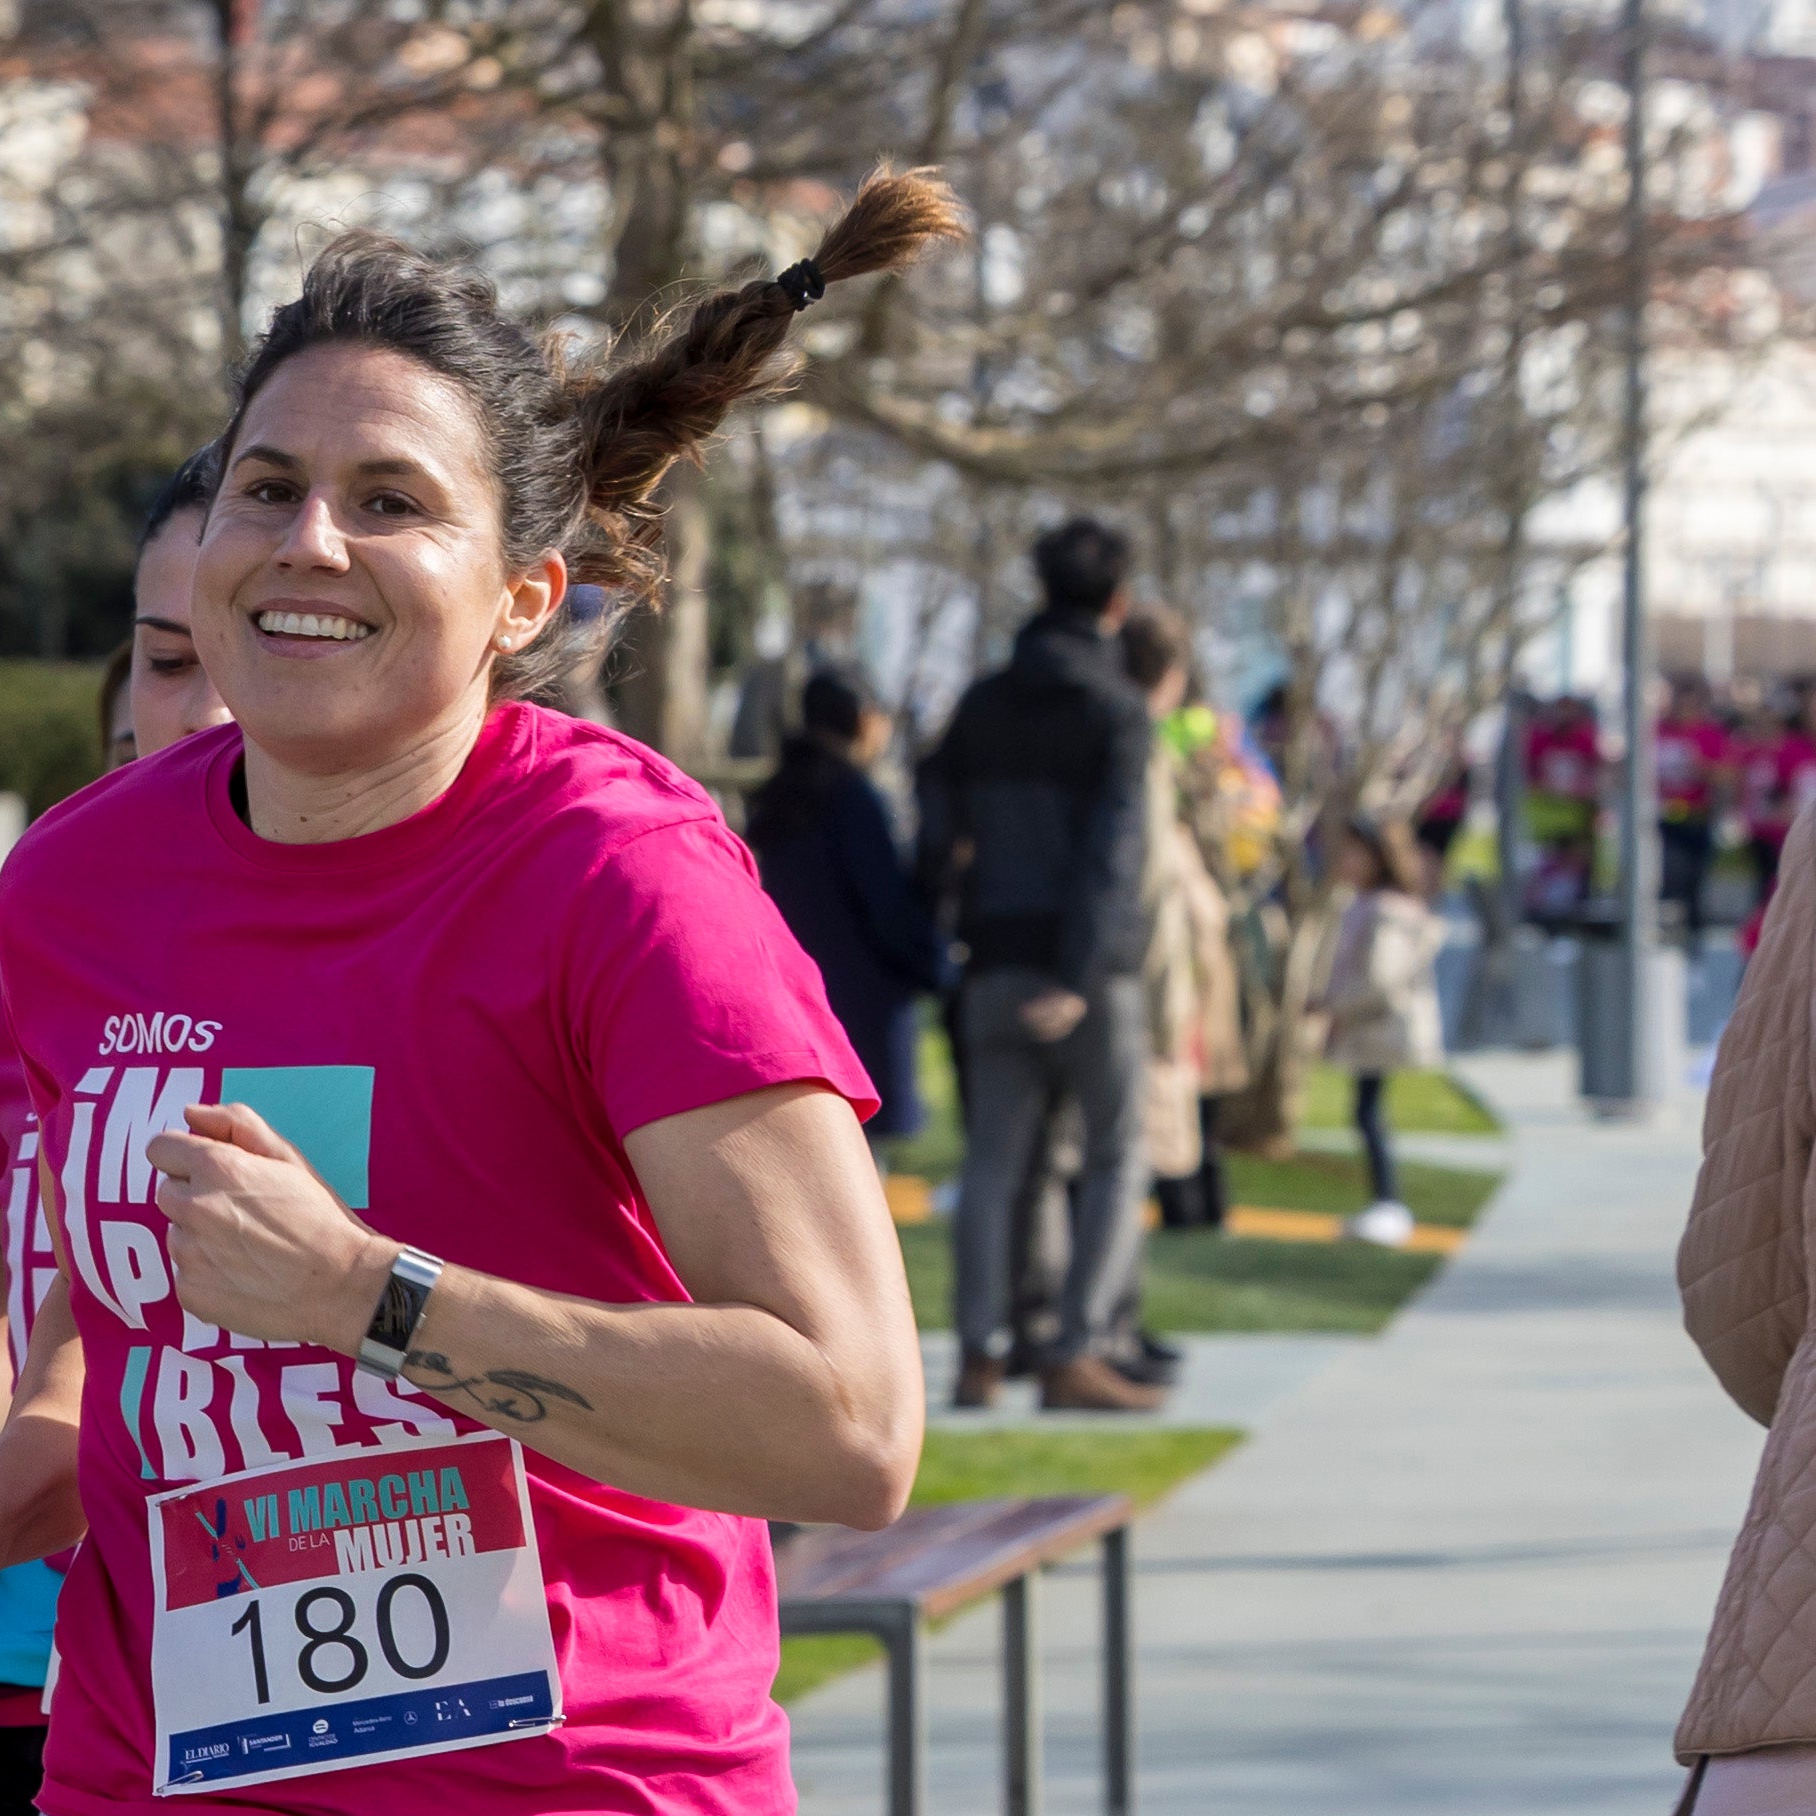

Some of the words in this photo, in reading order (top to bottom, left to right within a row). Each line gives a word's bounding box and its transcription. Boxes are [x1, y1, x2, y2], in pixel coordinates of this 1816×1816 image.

[98, 1011, 223, 1055] SOMOS
[243, 1494, 281, 1543] VI
[287, 1466, 471, 1533] MARCHA
[288, 1536, 308, 1552] DE
[310, 1532, 331, 1549] LA
[333, 1513, 476, 1576] MUJER
[230, 1571, 451, 1705] 180
